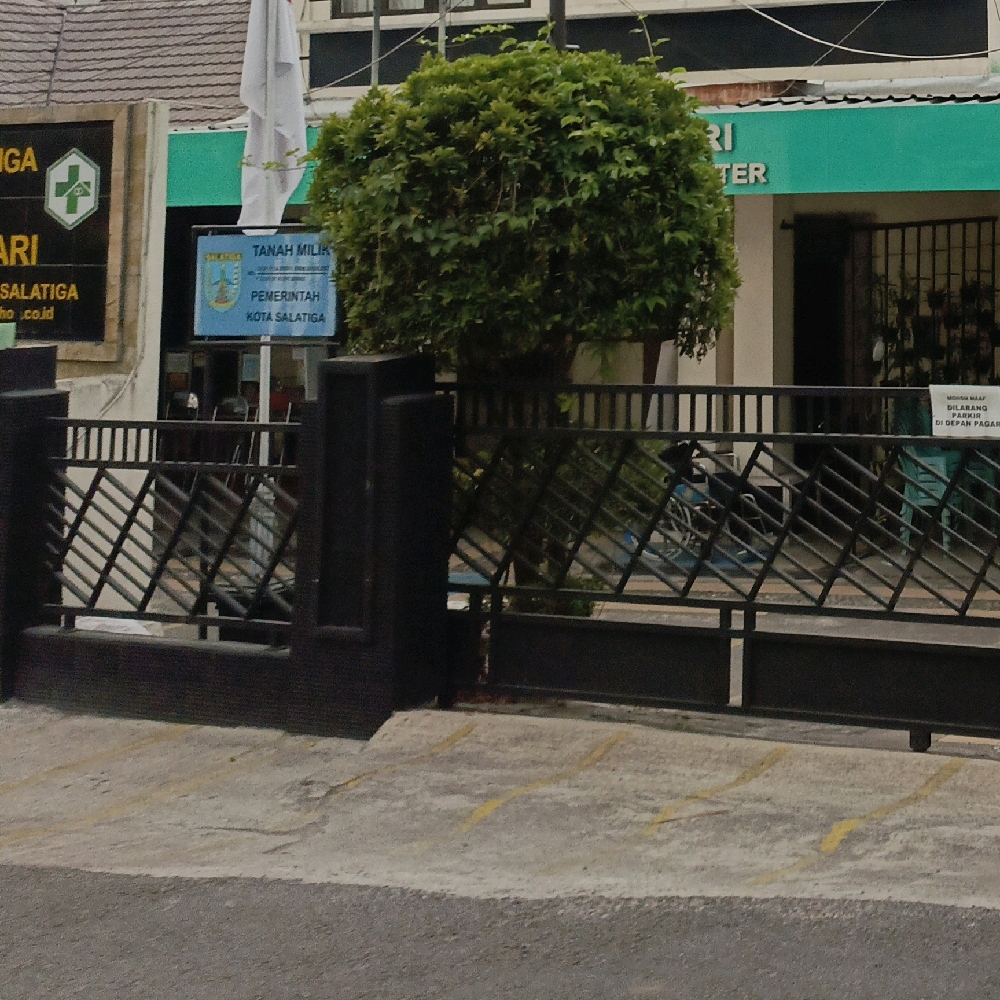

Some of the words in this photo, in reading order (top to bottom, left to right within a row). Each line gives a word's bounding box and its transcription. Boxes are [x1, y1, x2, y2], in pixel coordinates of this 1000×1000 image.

[252, 244, 294, 257] TANAH
[0, 283, 79, 300] SALATIGA
[251, 290, 320, 303] PEMERINTAH
[246, 312, 273, 322] KOTA
[275, 312, 326, 323] SALATIGA
